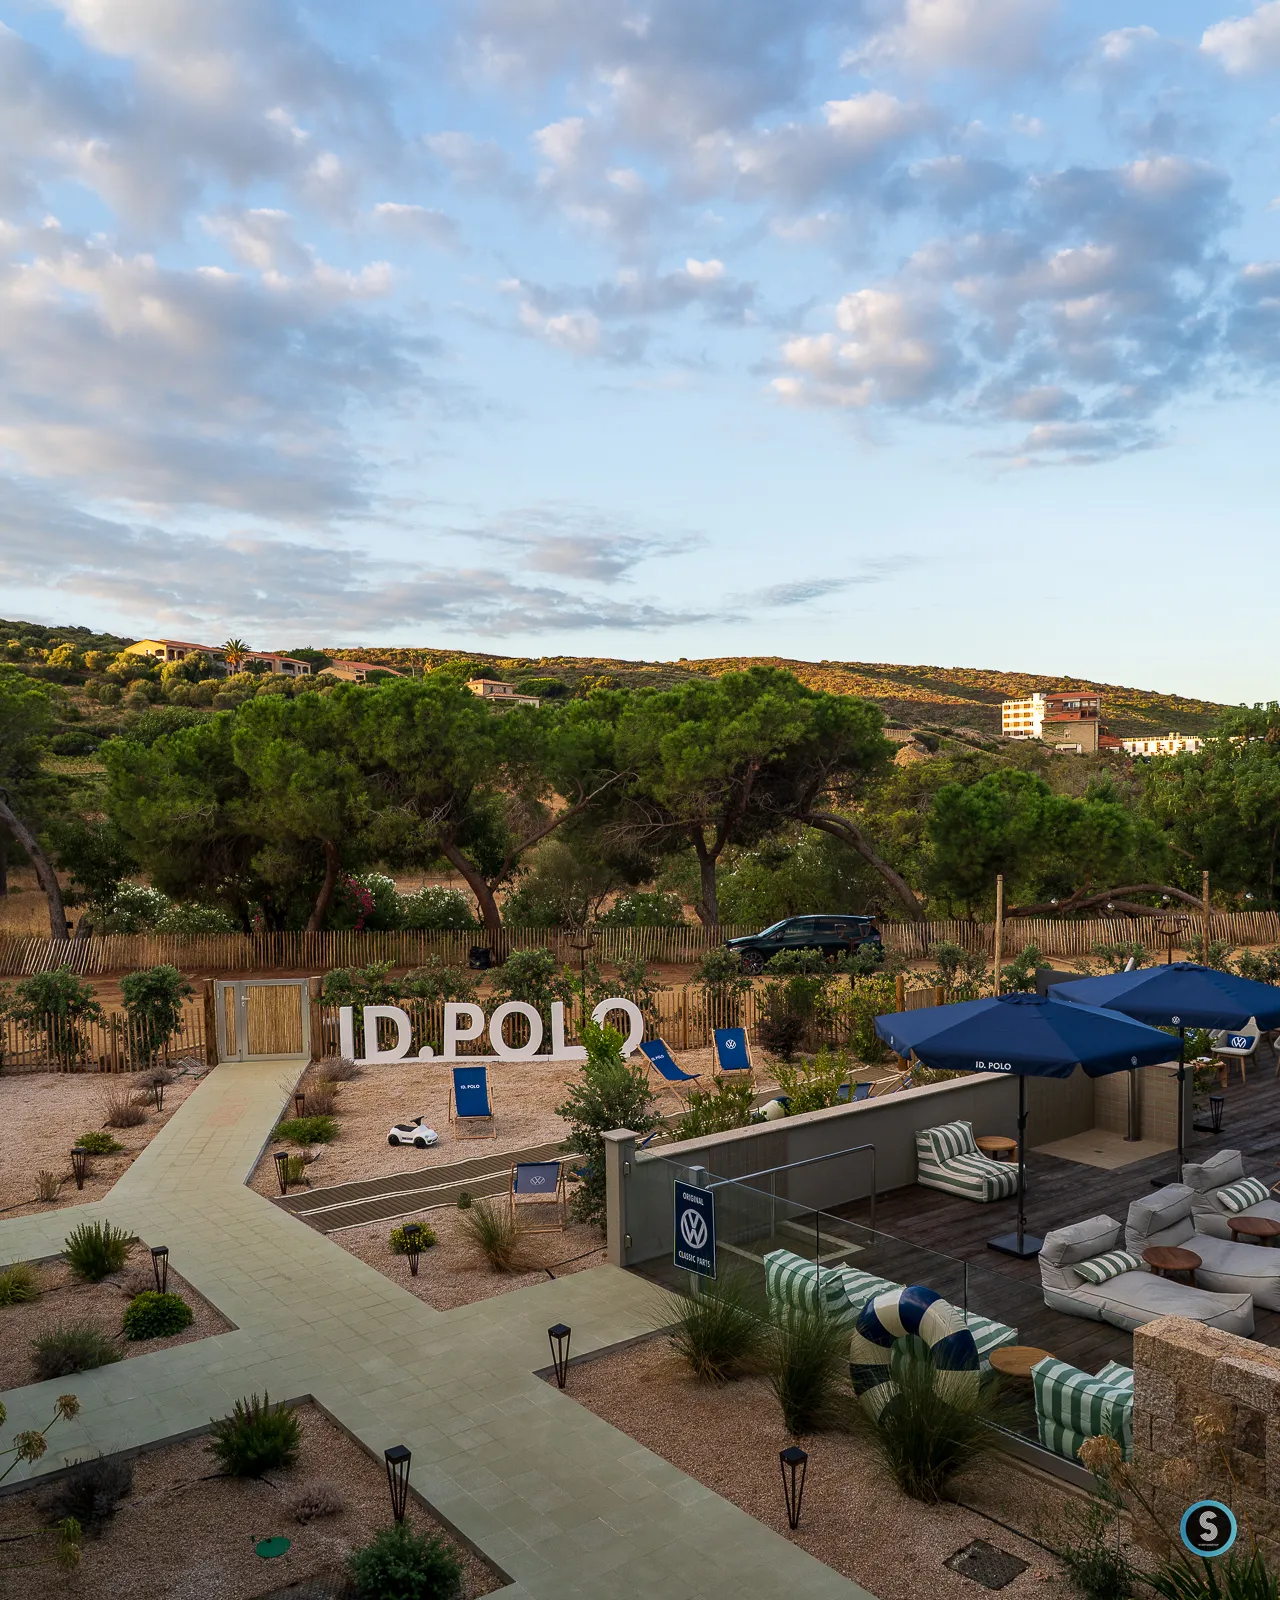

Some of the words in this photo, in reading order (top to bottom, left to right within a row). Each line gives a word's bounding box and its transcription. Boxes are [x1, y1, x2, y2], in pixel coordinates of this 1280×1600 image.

[339, 997, 644, 1060] ID.POLO
[975, 1061, 986, 1069] ID.
[988, 1062, 1012, 1070] POLO
[682, 1192, 704, 1205] ORIGINAL
[681, 1208, 707, 1248] VW
[678, 1250, 696, 1263] CLASSIC
[696, 1256, 711, 1268] PARTS
